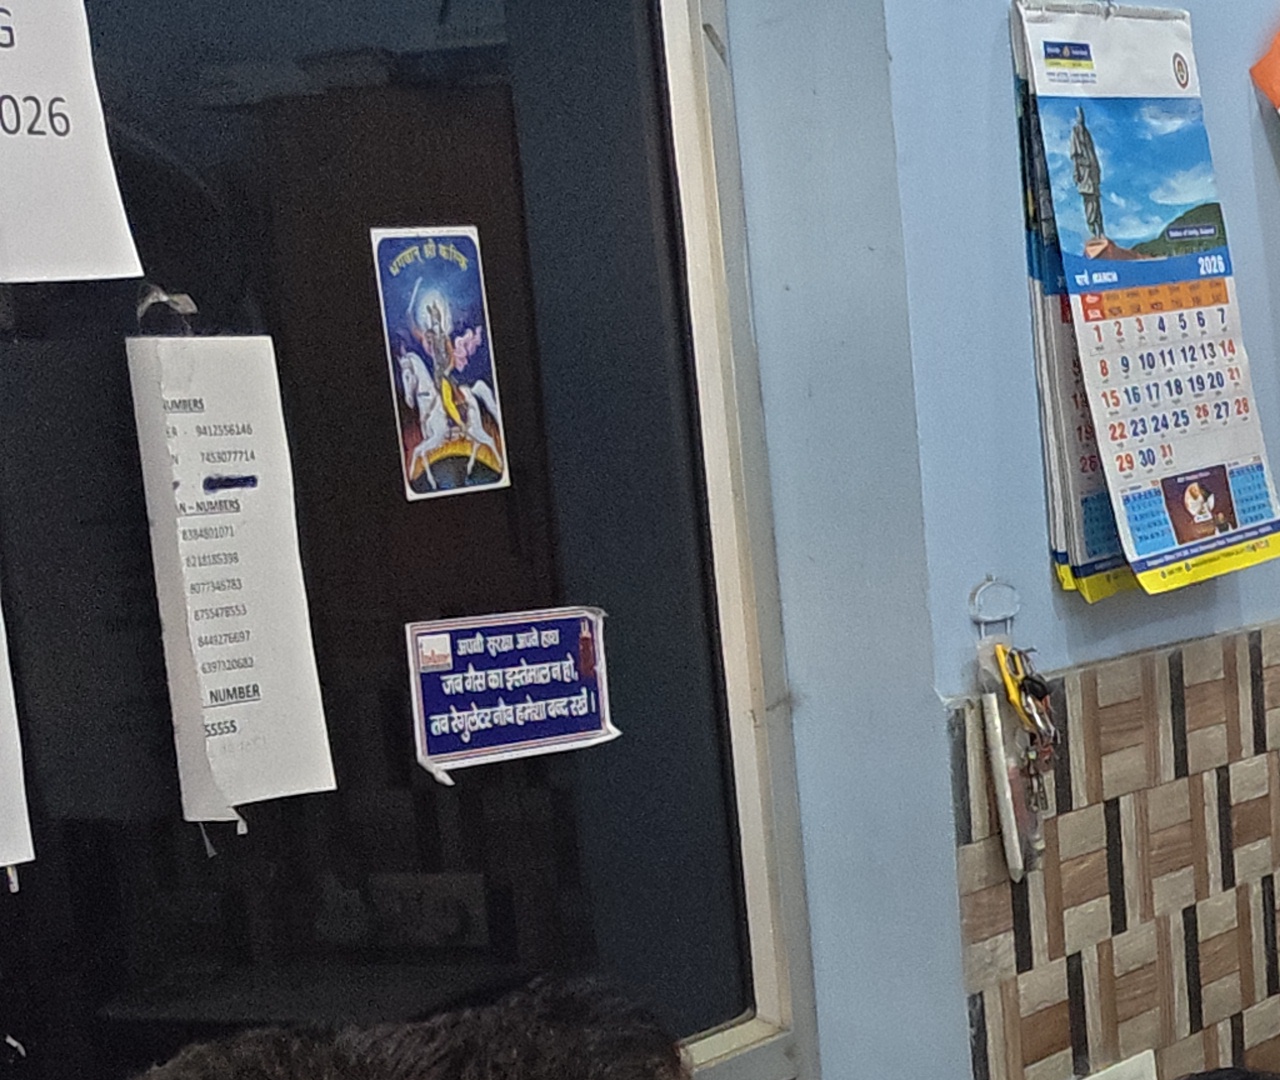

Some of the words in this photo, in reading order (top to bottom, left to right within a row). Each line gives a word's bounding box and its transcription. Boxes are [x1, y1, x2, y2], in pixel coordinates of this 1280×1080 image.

[1198, 255, 1225, 275] 2026
[1094, 325, 1102, 342] 1
[1114, 321, 1123, 336] 2
[1136, 318, 1144, 333] 3
[1158, 316, 1166, 332] 4
[1178, 313, 1186, 330] 5
[1196, 311, 1205, 327] 6
[1217, 308, 1225, 323] 7
[1100, 359, 1109, 377] 8
[1121, 356, 1130, 373] 9
[1139, 352, 1155, 370] 10
[1159, 348, 1175, 367] 11
[1181, 345, 1197, 363] 12
[1200, 342, 1216, 360] 13
[1219, 339, 1236, 357] 14
[1101, 390, 1120, 408] 15
[1124, 386, 1141, 404] 16
[1146, 382, 1160, 401] 17
[1165, 378, 1183, 397] 18
[1188, 375, 1205, 392] 19
[1207, 371, 1224, 389] 20
[1228, 367, 1240, 381] 21
[1109, 422, 1127, 441] 22
[1130, 418, 1148, 437] 23
[1151, 414, 1169, 432] 24
[1172, 410, 1189, 428] 25
[1195, 404, 1209, 419] 26
[1214, 401, 1229, 419] 27
[1235, 397, 1249, 415] 28
[1116, 454, 1134, 472] 29
[1139, 448, 1155, 467] 30
[1160, 444, 1173, 458] 31
[209, 683, 261, 704] NUMBER
[440, 673, 464, 695] जब
[465, 663, 486, 692] गैस
[487, 669, 504, 690] का
[504, 658, 550, 690] इस्तेमाल
[551, 662, 561, 681] न
[429, 714, 449, 736] तब
[516, 694, 546, 726] हमेशा
